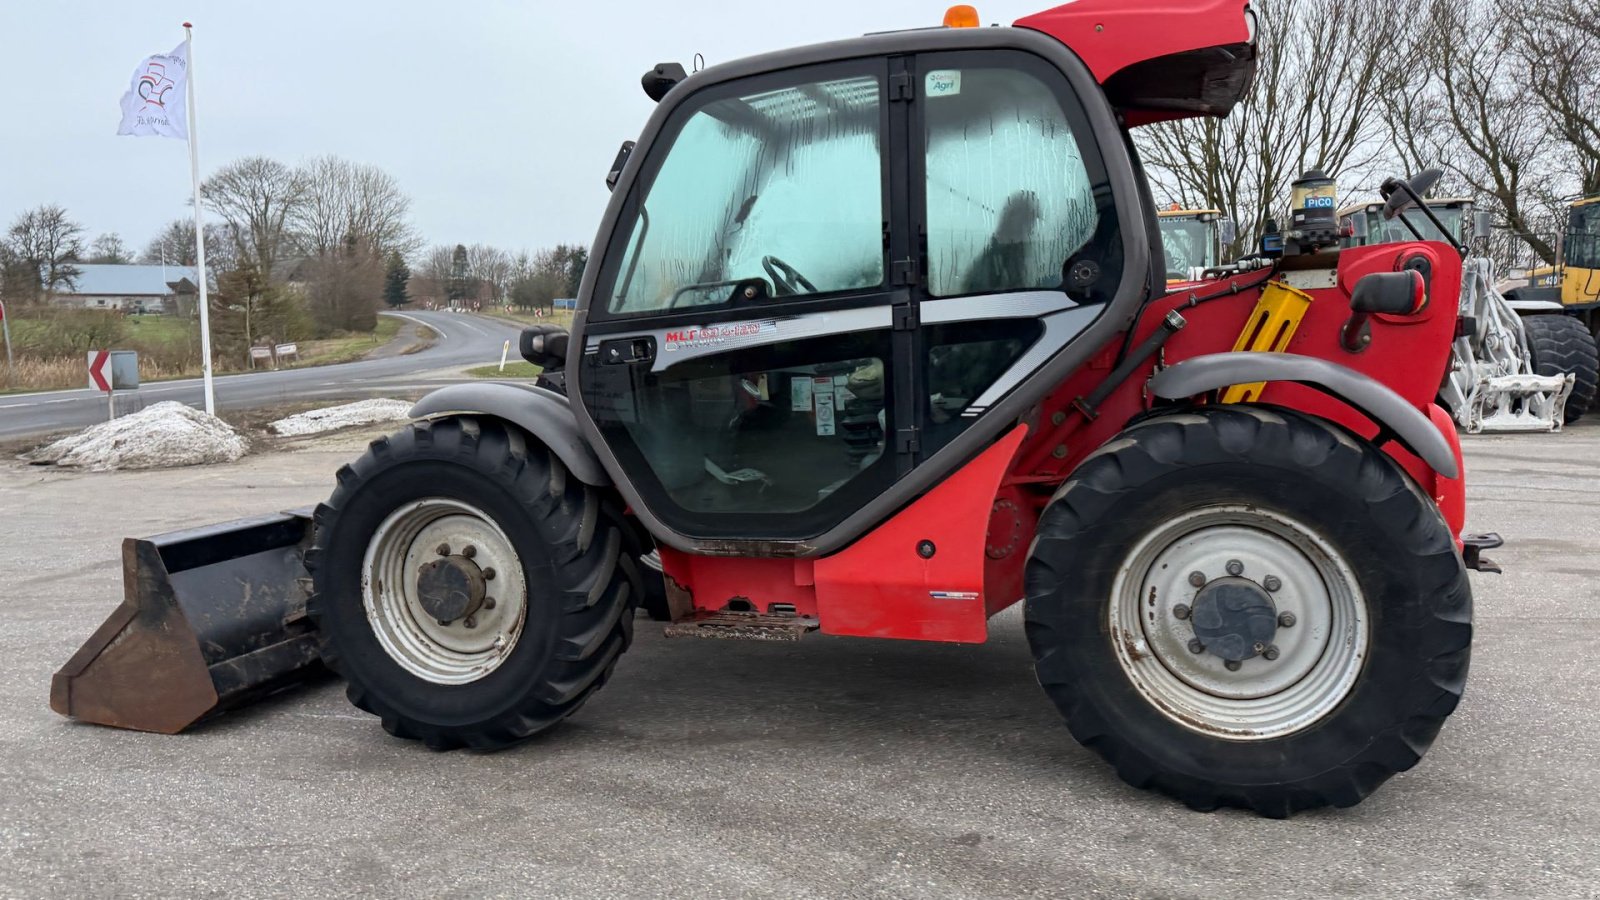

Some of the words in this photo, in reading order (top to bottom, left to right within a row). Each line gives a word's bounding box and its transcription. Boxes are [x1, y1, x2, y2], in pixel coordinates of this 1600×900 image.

[934, 80, 954, 91] Agri
[1308, 197, 1332, 208] PICO
[666, 329, 697, 342] MLT
